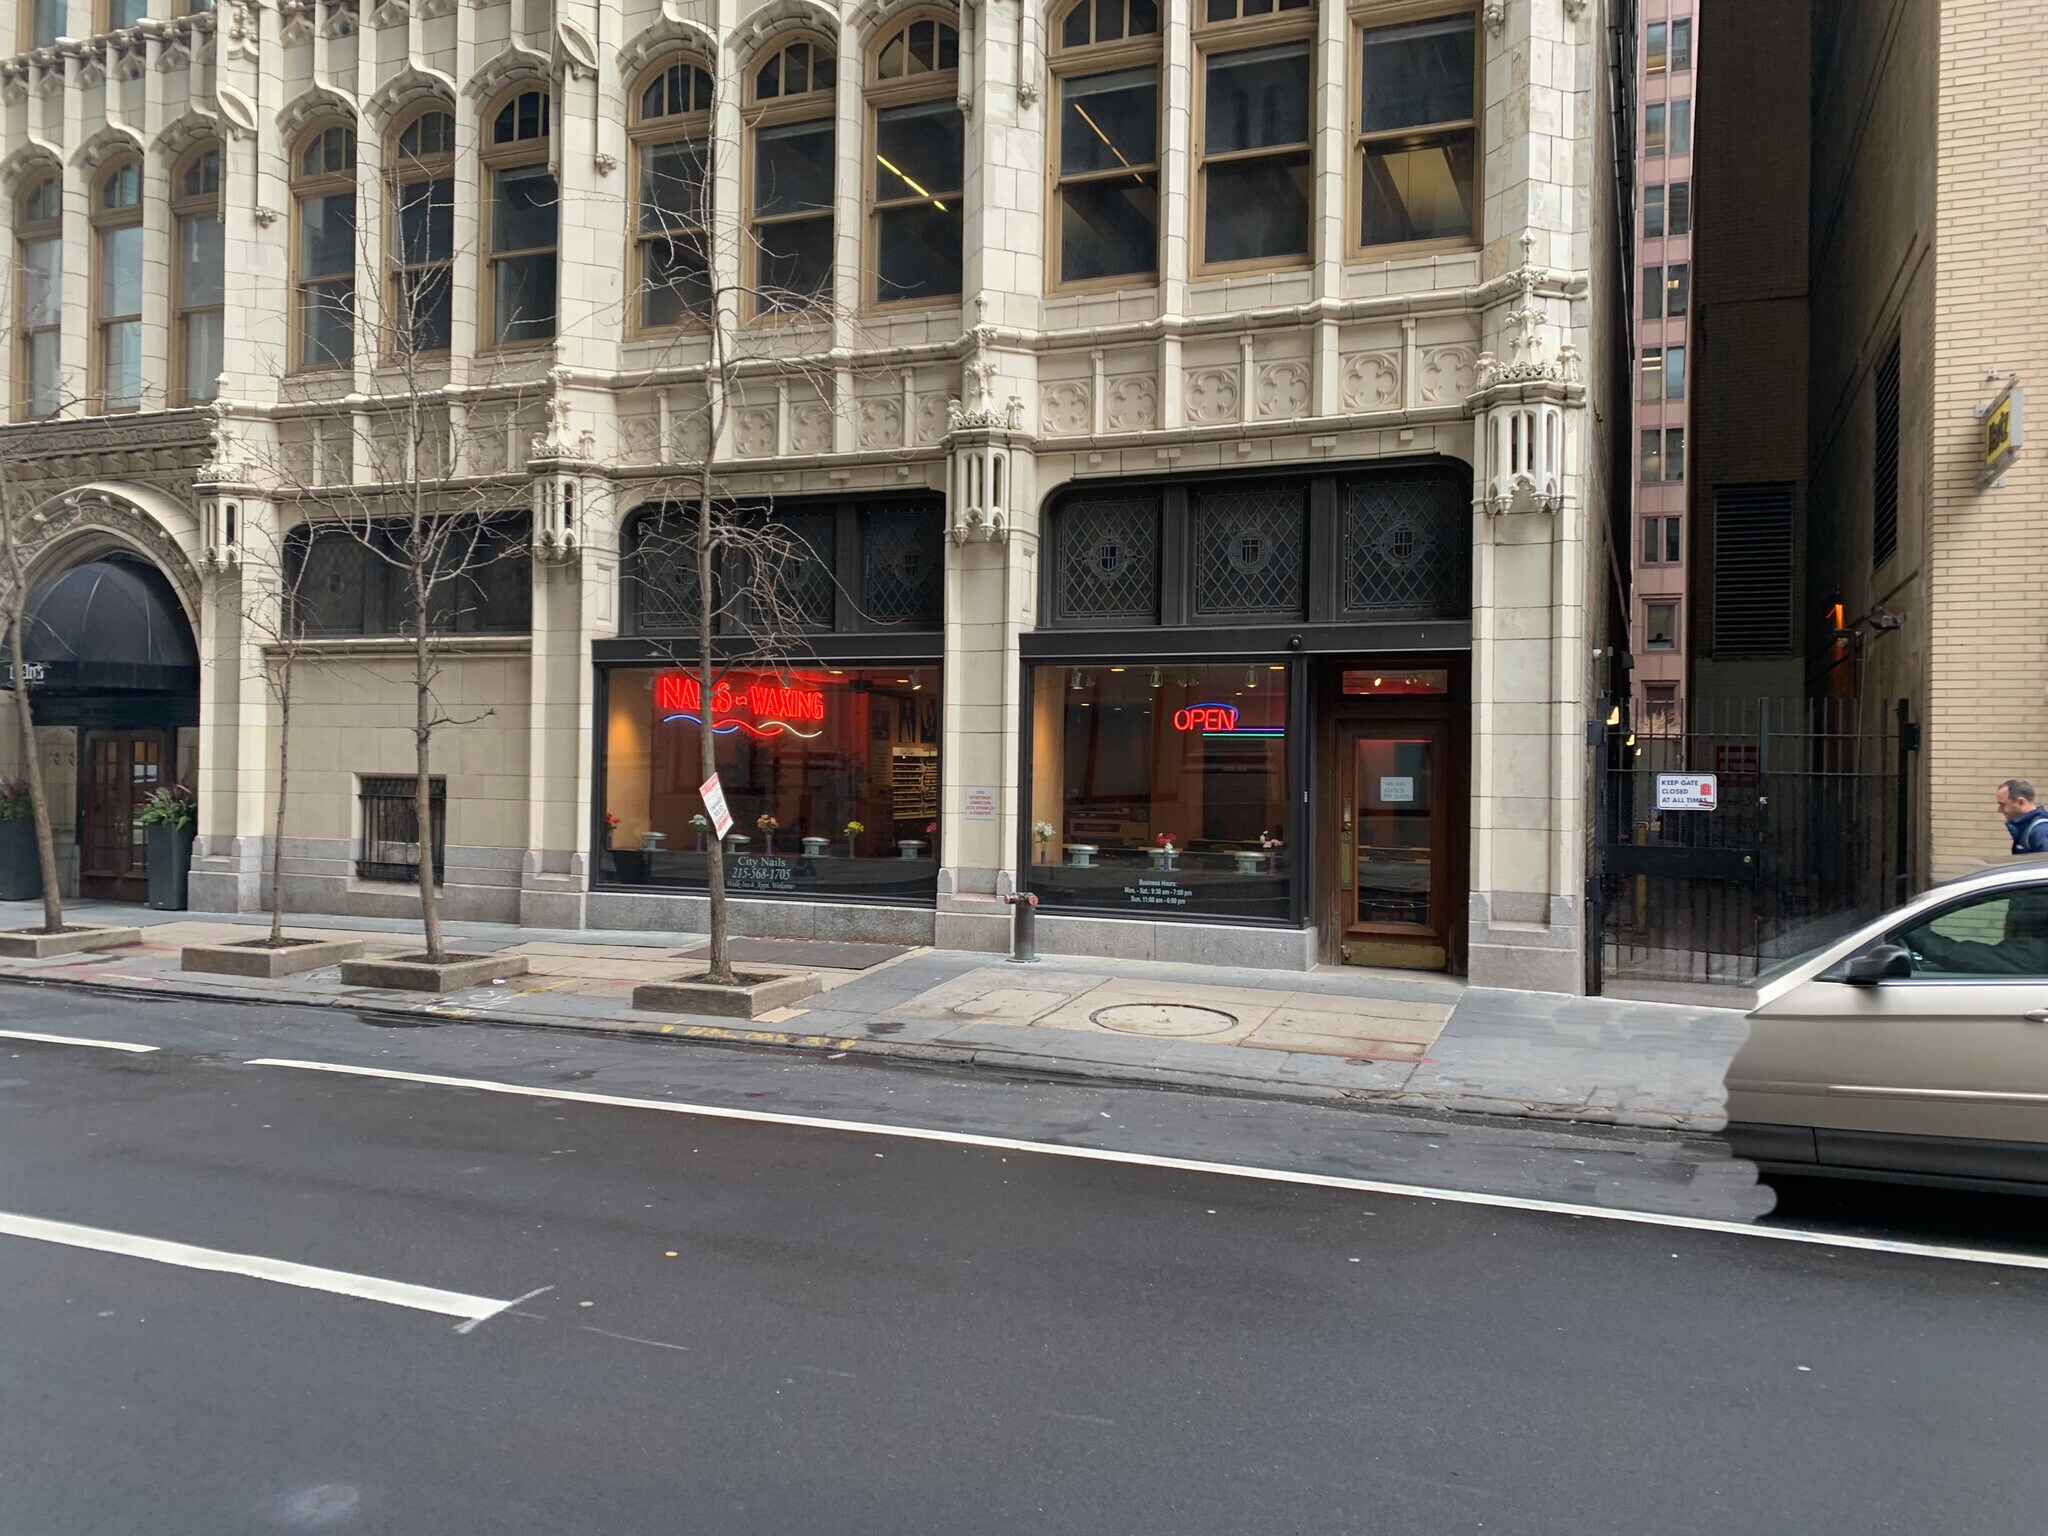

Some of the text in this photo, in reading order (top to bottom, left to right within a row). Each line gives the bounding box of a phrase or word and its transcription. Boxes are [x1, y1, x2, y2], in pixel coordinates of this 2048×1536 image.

[751, 685, 824, 720] WAXING
[1174, 709, 1235, 731] OPEN
[737, 856, 786, 868] City Nails
[732, 867, 791, 880] 215-568-1705
